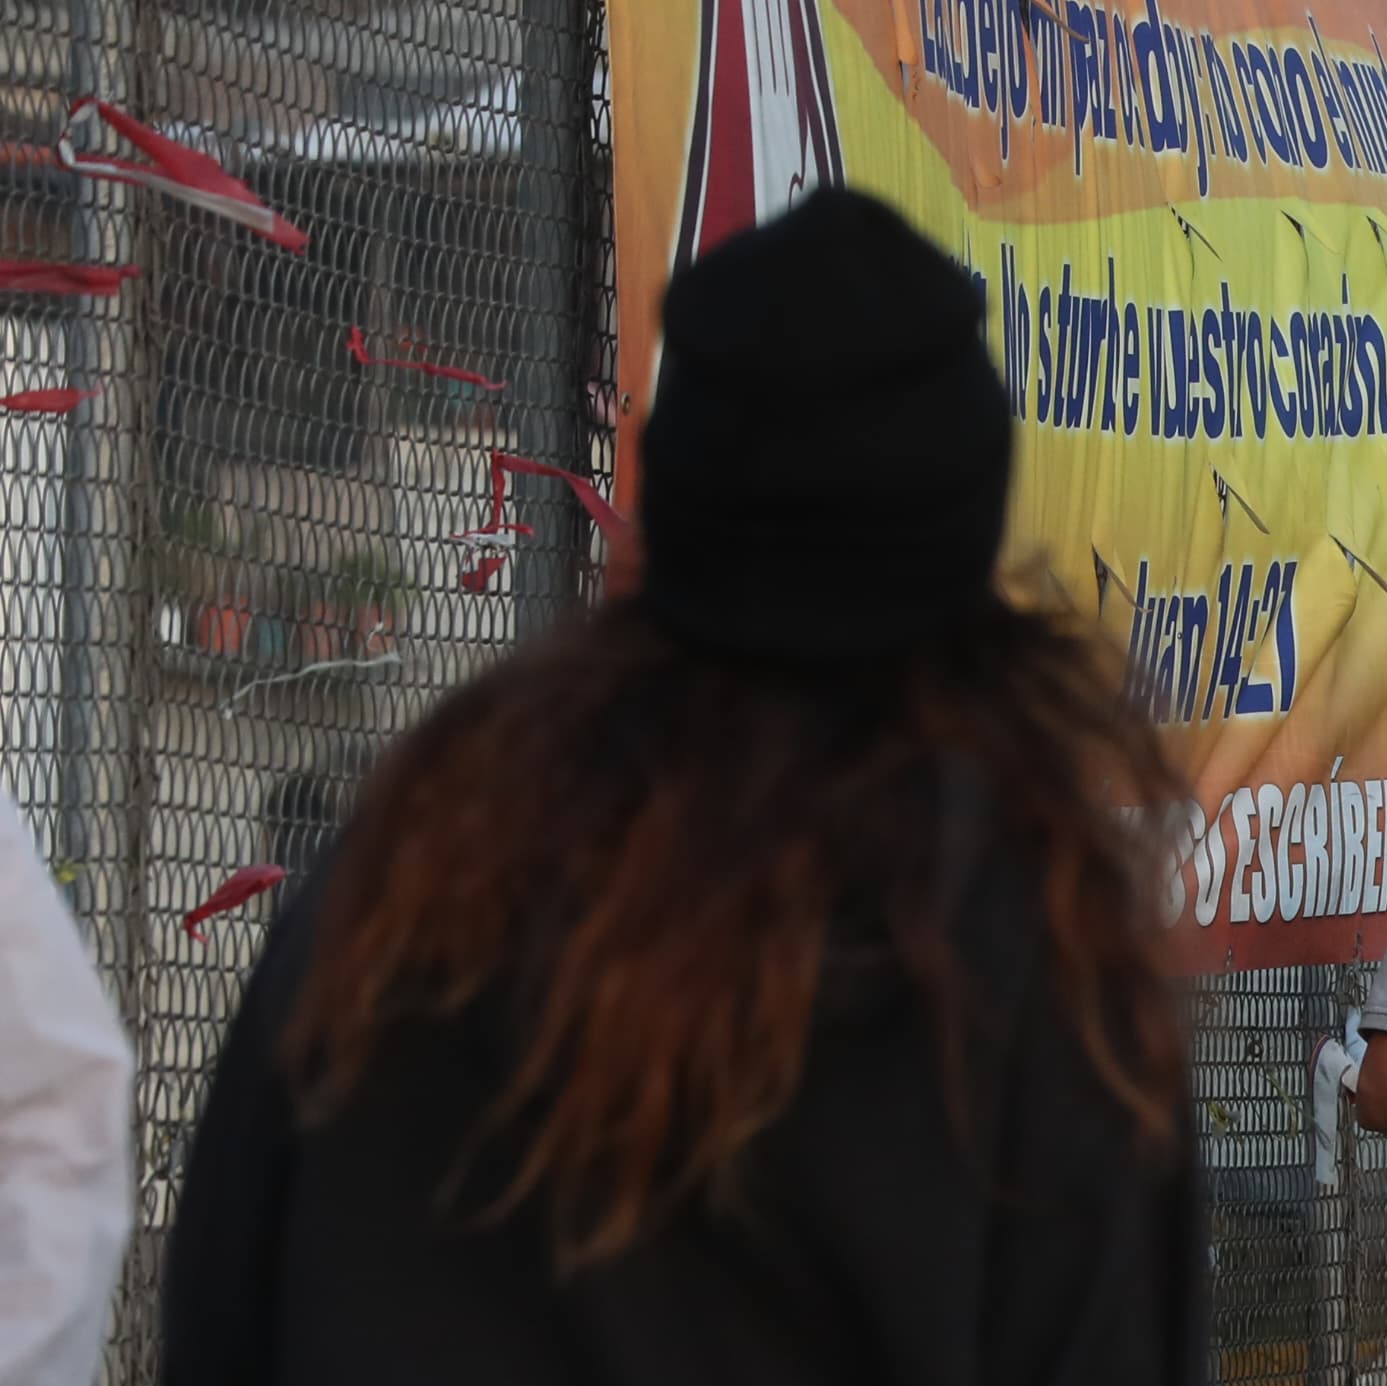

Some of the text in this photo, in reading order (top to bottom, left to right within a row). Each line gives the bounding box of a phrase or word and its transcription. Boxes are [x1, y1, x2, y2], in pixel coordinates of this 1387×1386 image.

[1001, 243, 1031, 421] No
[1053, 256, 1141, 436] turbe
[1147, 281, 1267, 440] vuestro
[1118, 560, 1209, 724] Juan
